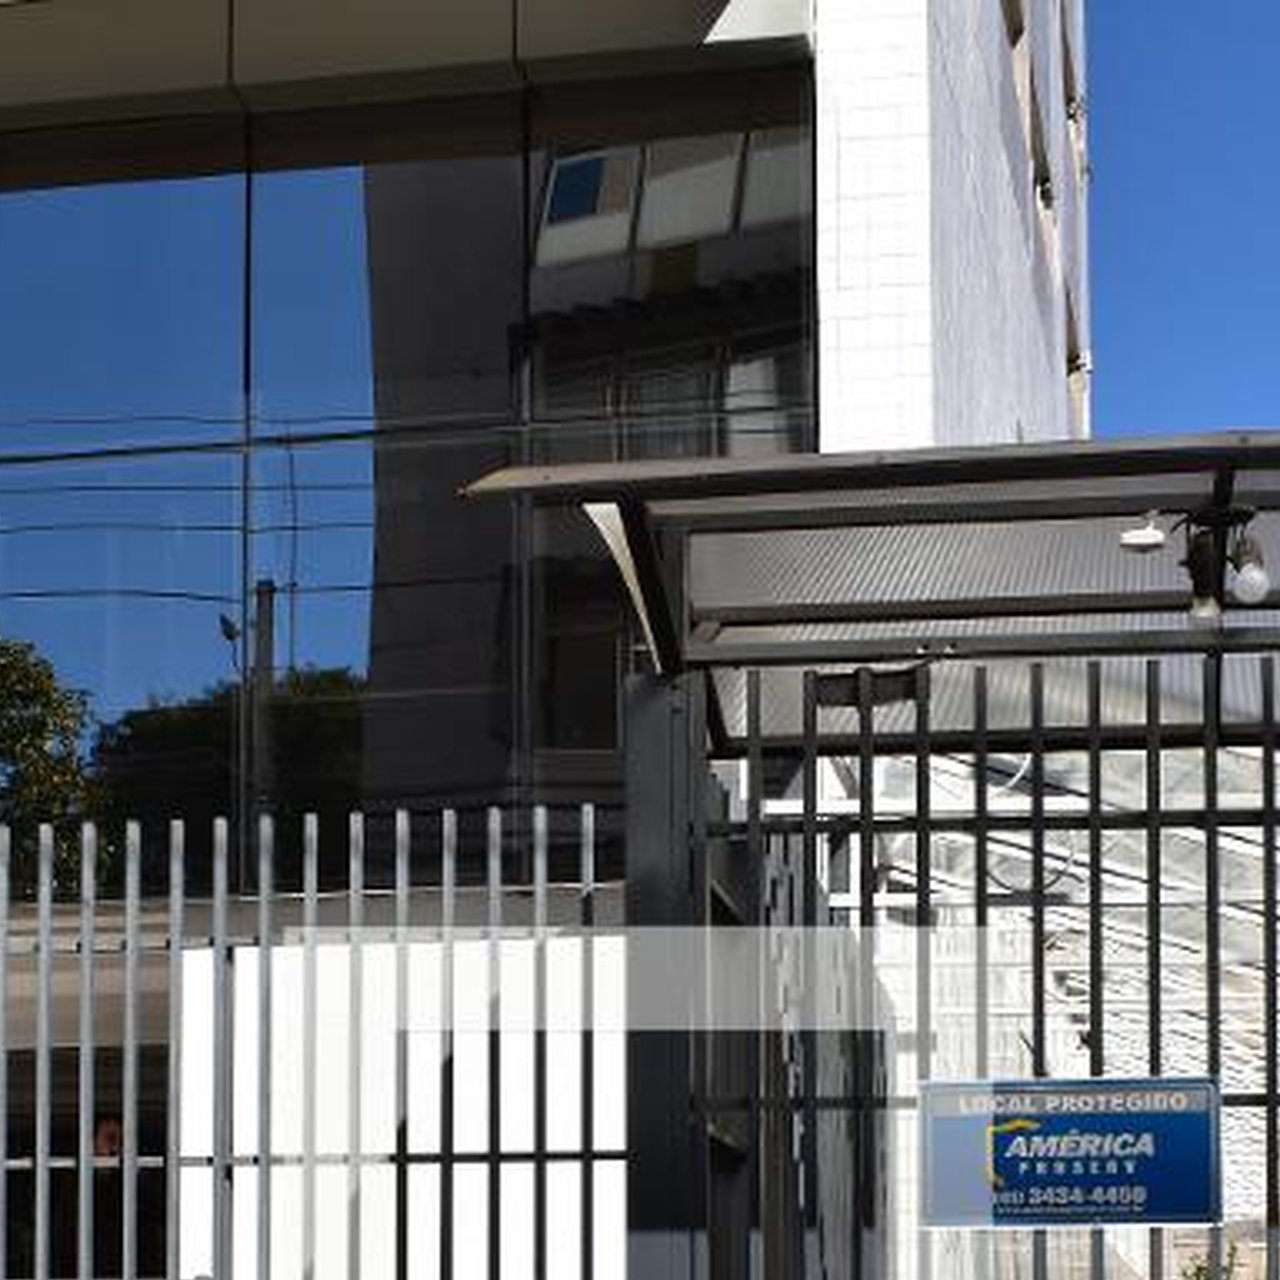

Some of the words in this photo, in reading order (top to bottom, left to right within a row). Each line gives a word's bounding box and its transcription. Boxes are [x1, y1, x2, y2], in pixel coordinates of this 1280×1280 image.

[959, 1095, 1037, 1114] LOCAL
[1045, 1092, 1187, 1113] PROTEGIDO
[1004, 1129, 1155, 1158] AMÉRICA
